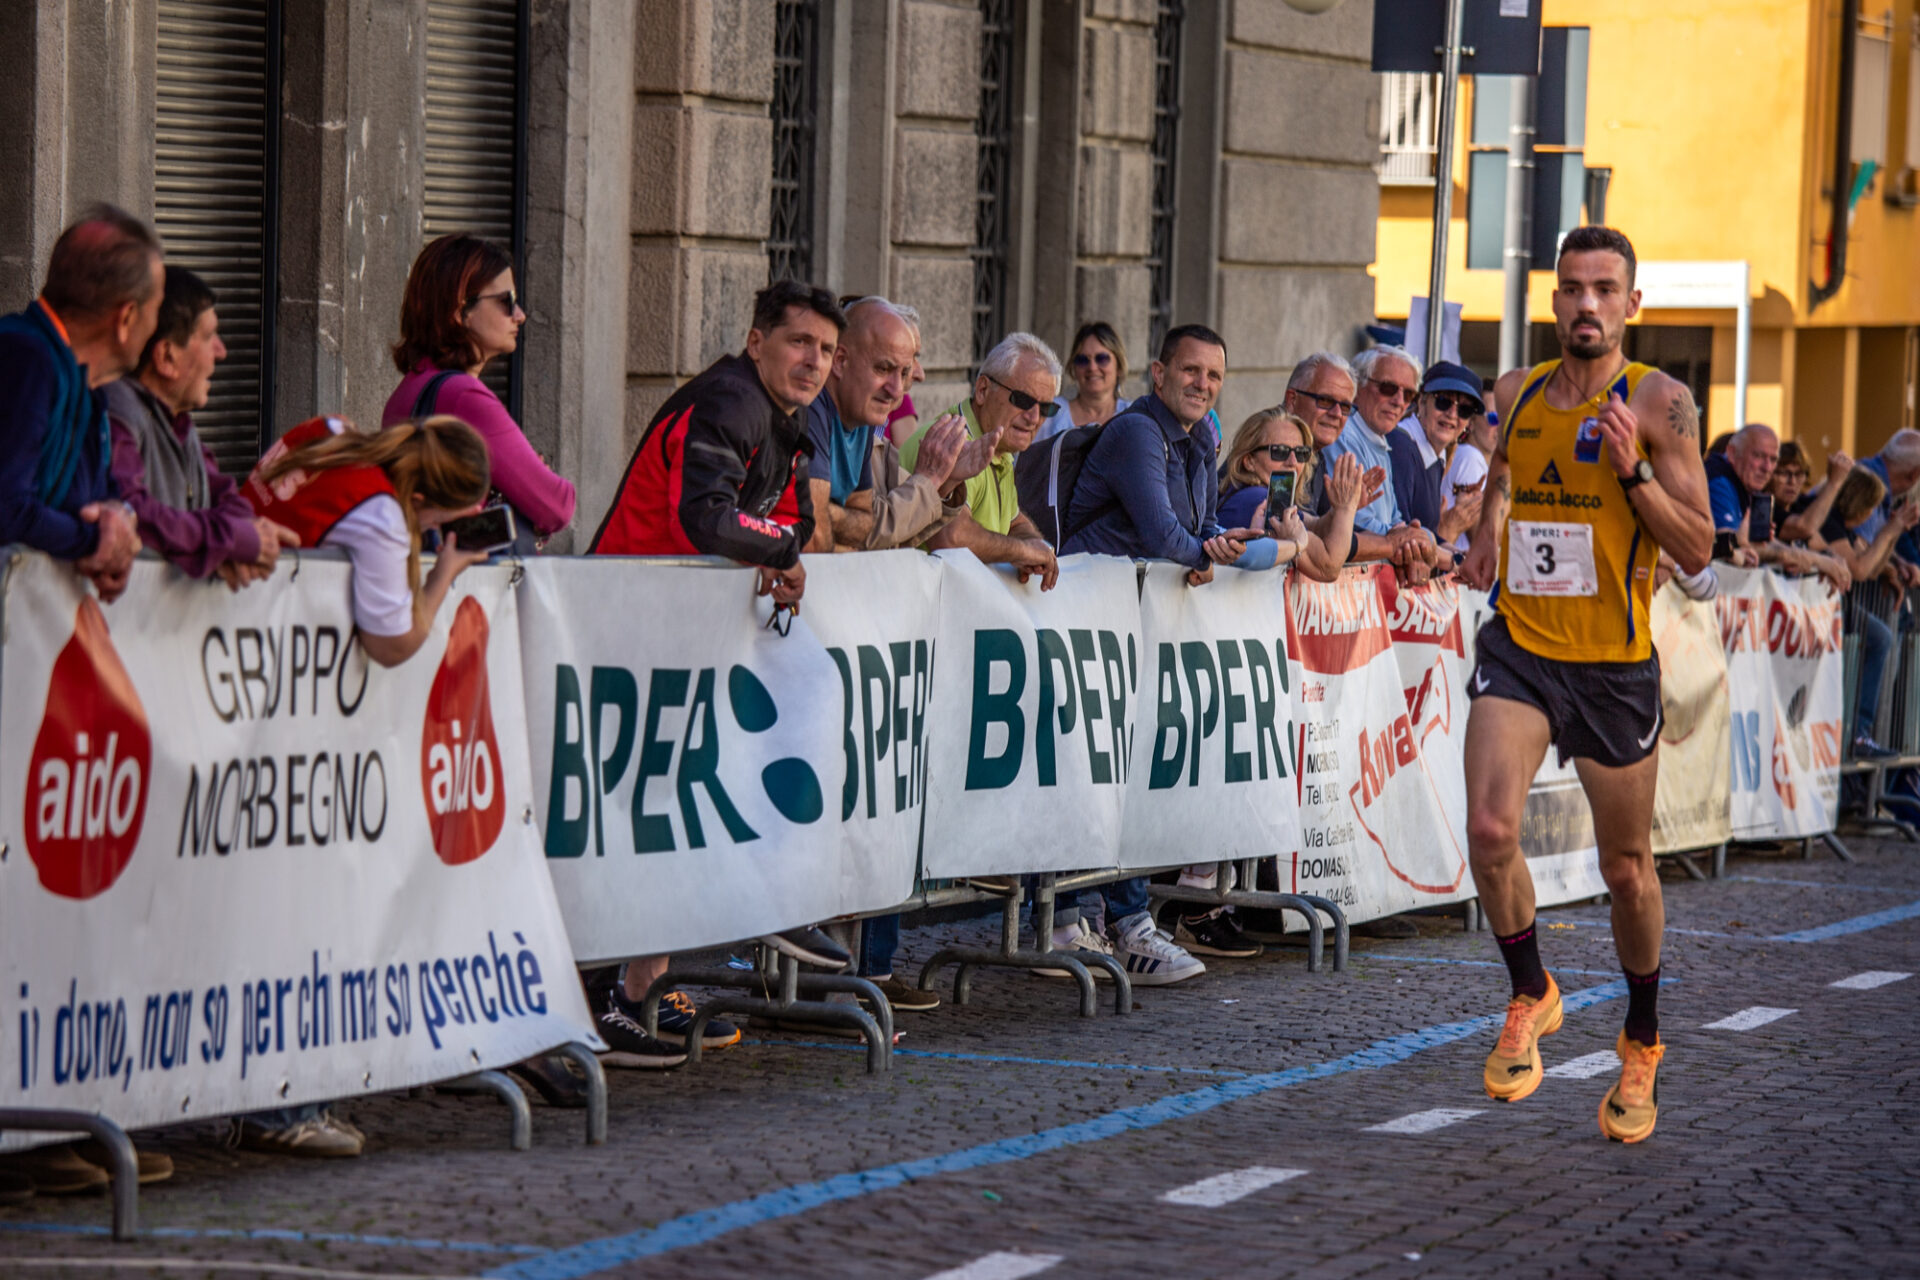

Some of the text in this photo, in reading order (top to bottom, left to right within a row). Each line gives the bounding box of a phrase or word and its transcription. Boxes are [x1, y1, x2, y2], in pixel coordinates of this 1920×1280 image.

[1535, 543, 1556, 575] 3
[202, 624, 369, 724] GRUPPO
[38, 732, 142, 841] aido
[177, 750, 388, 858] MORBEGNO
[430, 720, 494, 815] aido
[1304, 827, 1323, 847] Via
[54, 977, 133, 1093] dono,
[140, 989, 193, 1071] non
[201, 984, 229, 1064] so
[241, 978, 292, 1080] per
[298, 948, 334, 1050] chi
[341, 966, 377, 1043] ma
[385, 961, 411, 1037] so
[419, 931, 547, 1050] perchè
